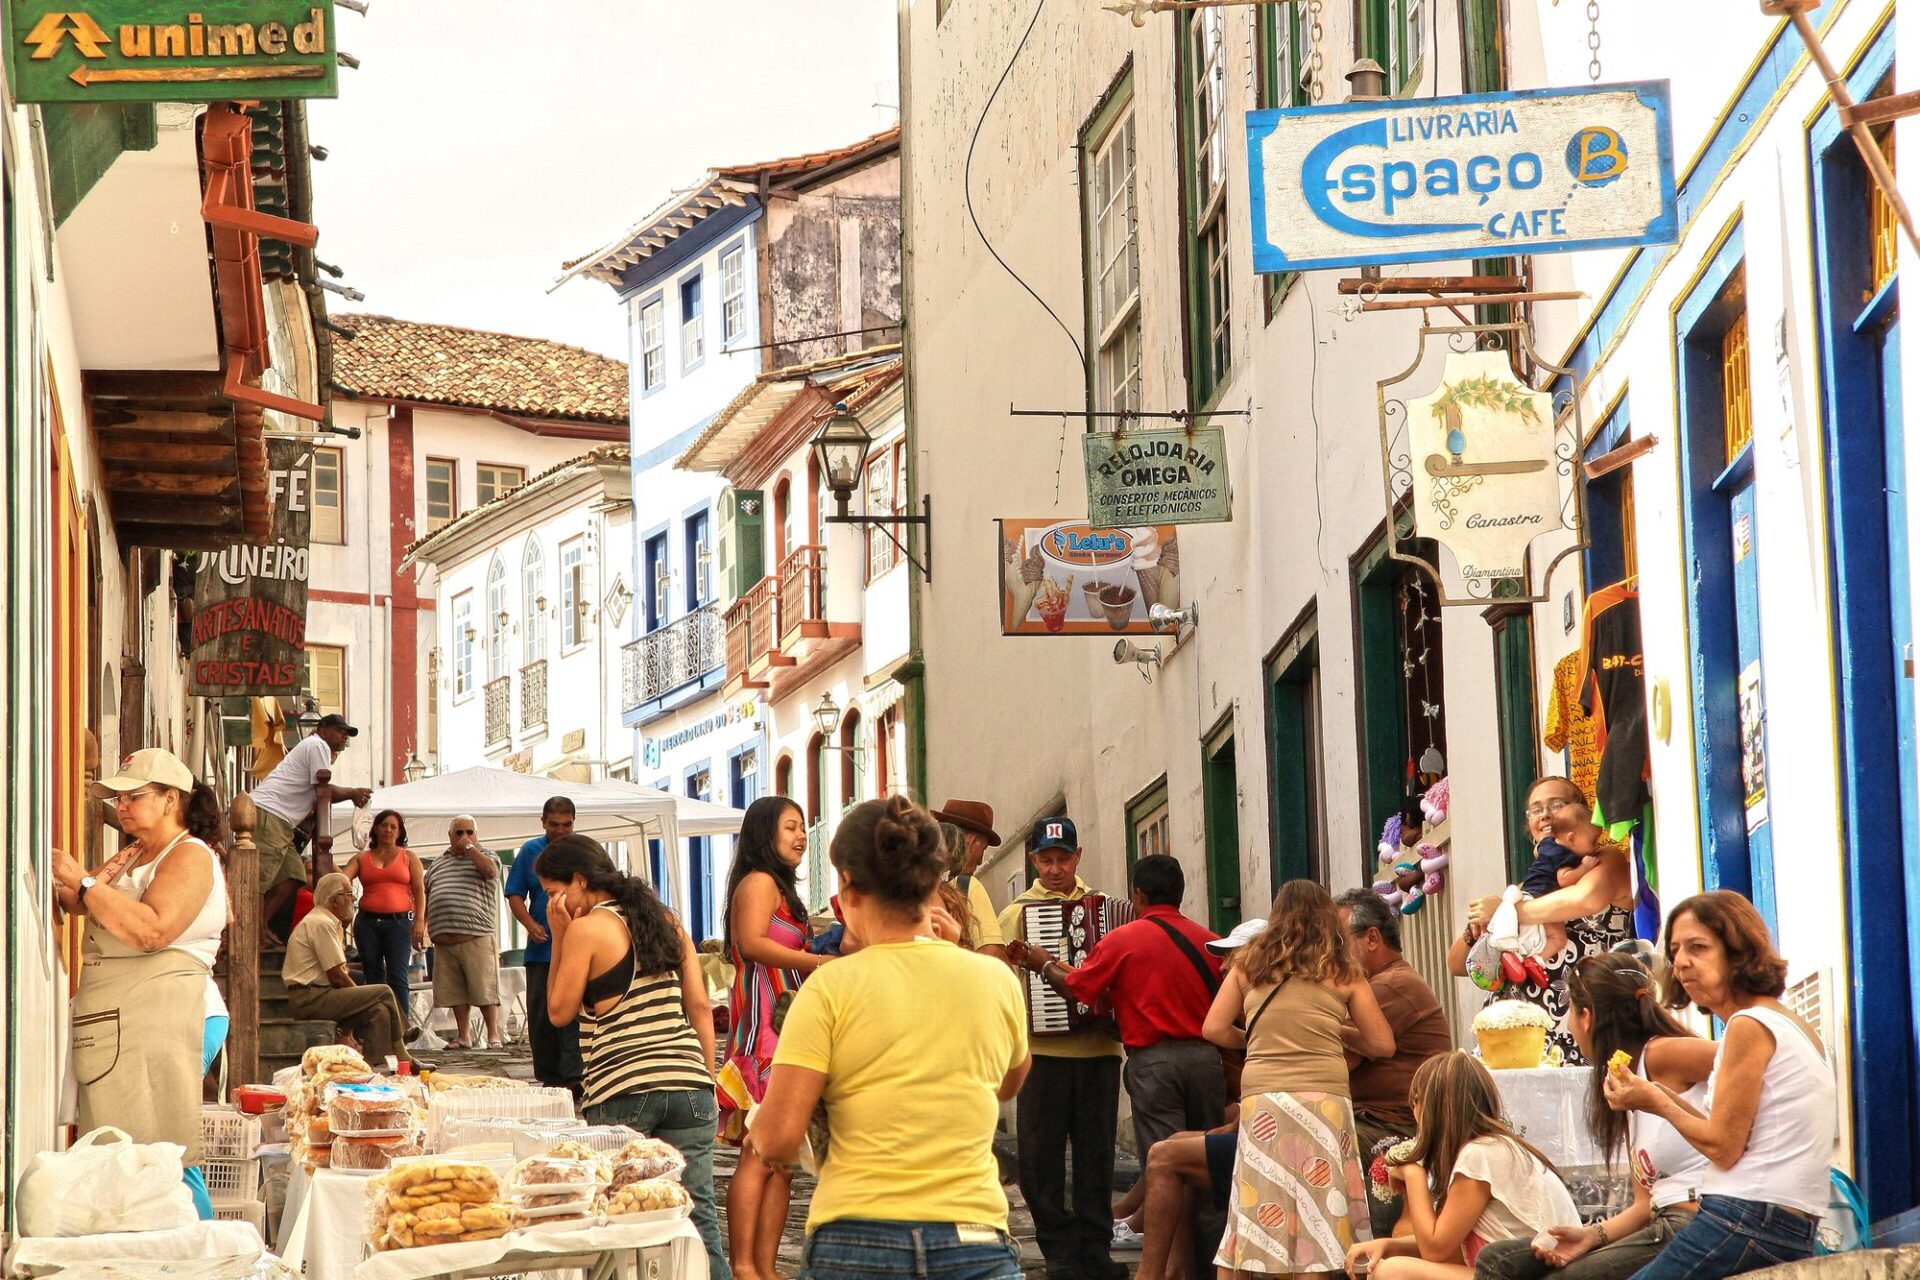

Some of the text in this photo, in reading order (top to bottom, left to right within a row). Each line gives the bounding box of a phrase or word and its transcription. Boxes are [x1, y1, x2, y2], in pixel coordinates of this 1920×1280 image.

[119, 7, 326, 58] unimed
[1392, 109, 1518, 143] LIVRARIA
[1578, 125, 1629, 182] B
[1302, 118, 1543, 237] Espaço
[1097, 441, 1216, 479] RELOJOARIA
[1121, 465, 1191, 487] OMEGA
[267, 452, 310, 512] FÉ
[1100, 487, 1217, 506] CONSERTOS MECÂNICOS
[1115, 506, 1122, 517] E
[1466, 513, 1544, 530] Canastra
[1068, 532, 1126, 551] Lelu's
[1462, 564, 1523, 579] Diamantina
[191, 599, 305, 650] ARTESANATOS
[242, 634, 251, 651] E
[195, 654, 298, 687] CRISTAIS
[1098, 905, 1106, 939] VERSAL
